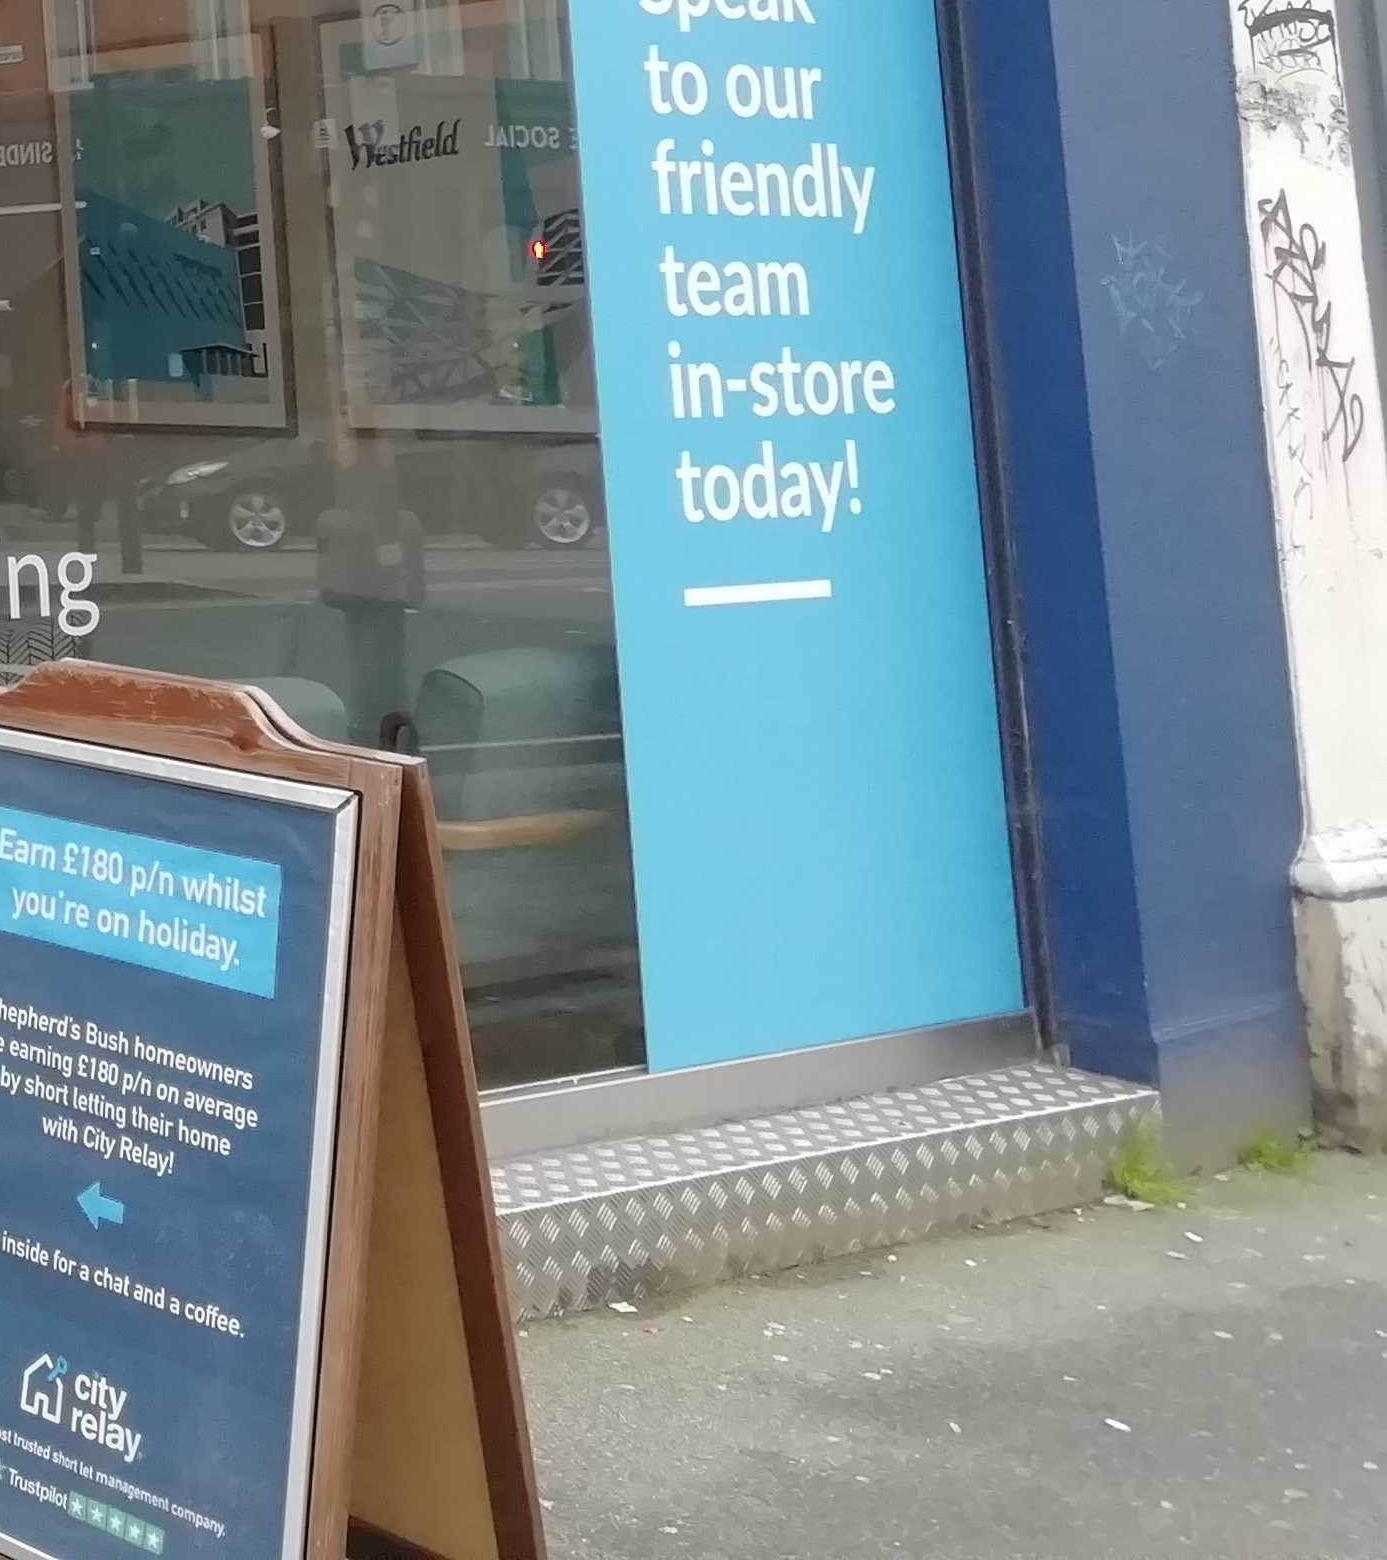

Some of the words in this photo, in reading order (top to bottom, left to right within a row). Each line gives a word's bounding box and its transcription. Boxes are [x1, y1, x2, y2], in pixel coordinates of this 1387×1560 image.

[643, 43, 708, 115] to
[726, 63, 821, 120] our
[344, 118, 462, 171] Westfield
[651, 138, 875, 234] friendly
[659, 245, 810, 317] team
[668, 340, 895, 418] in-store
[676, 440, 861, 532] today!
[63, 842, 123, 884] £180
[131, 860, 174, 898] p/n
[182, 870, 267, 920] whilst
[12, 883, 90, 930] you're
[97, 911, 129, 939] on
[138, 910, 240, 971] holiday.
[9, 1038, 72, 1079] earning
[77, 1057, 118, 1087] £180
[122, 1070, 152, 1099] p/n
[156, 1083, 179, 1104] on
[184, 1092, 258, 1129] average
[86, 1022, 128, 1055] Bush
[134, 1037, 253, 1090] homeowners
[0, 1067, 19, 1094] by
[24, 1077, 68, 1108] short
[73, 1088, 126, 1127] letting
[131, 1106, 173, 1138] their
[178, 1122, 231, 1156] home
[42, 1117, 78, 1144] with
[83, 1127, 115, 1159] City
[120, 1138, 174, 1176] Relay!
[2, 1230, 49, 1266] inside
[53, 1249, 76, 1276] for
[79, 1263, 90, 1282] a
[93, 1268, 130, 1297] chat
[133, 1282, 165, 1310] and
[169, 1296, 180, 1315] a
[184, 1302, 246, 1338] coffee.
[75, 1370, 127, 1419] city
[7, 1467, 68, 1510] Trustpilot
[13, 1431, 50, 1461] trusted
[52, 1443, 77, 1471] short
[79, 1459, 93, 1479] let
[96, 1467, 169, 1512] management
[171, 1499, 226, 1537] company.
